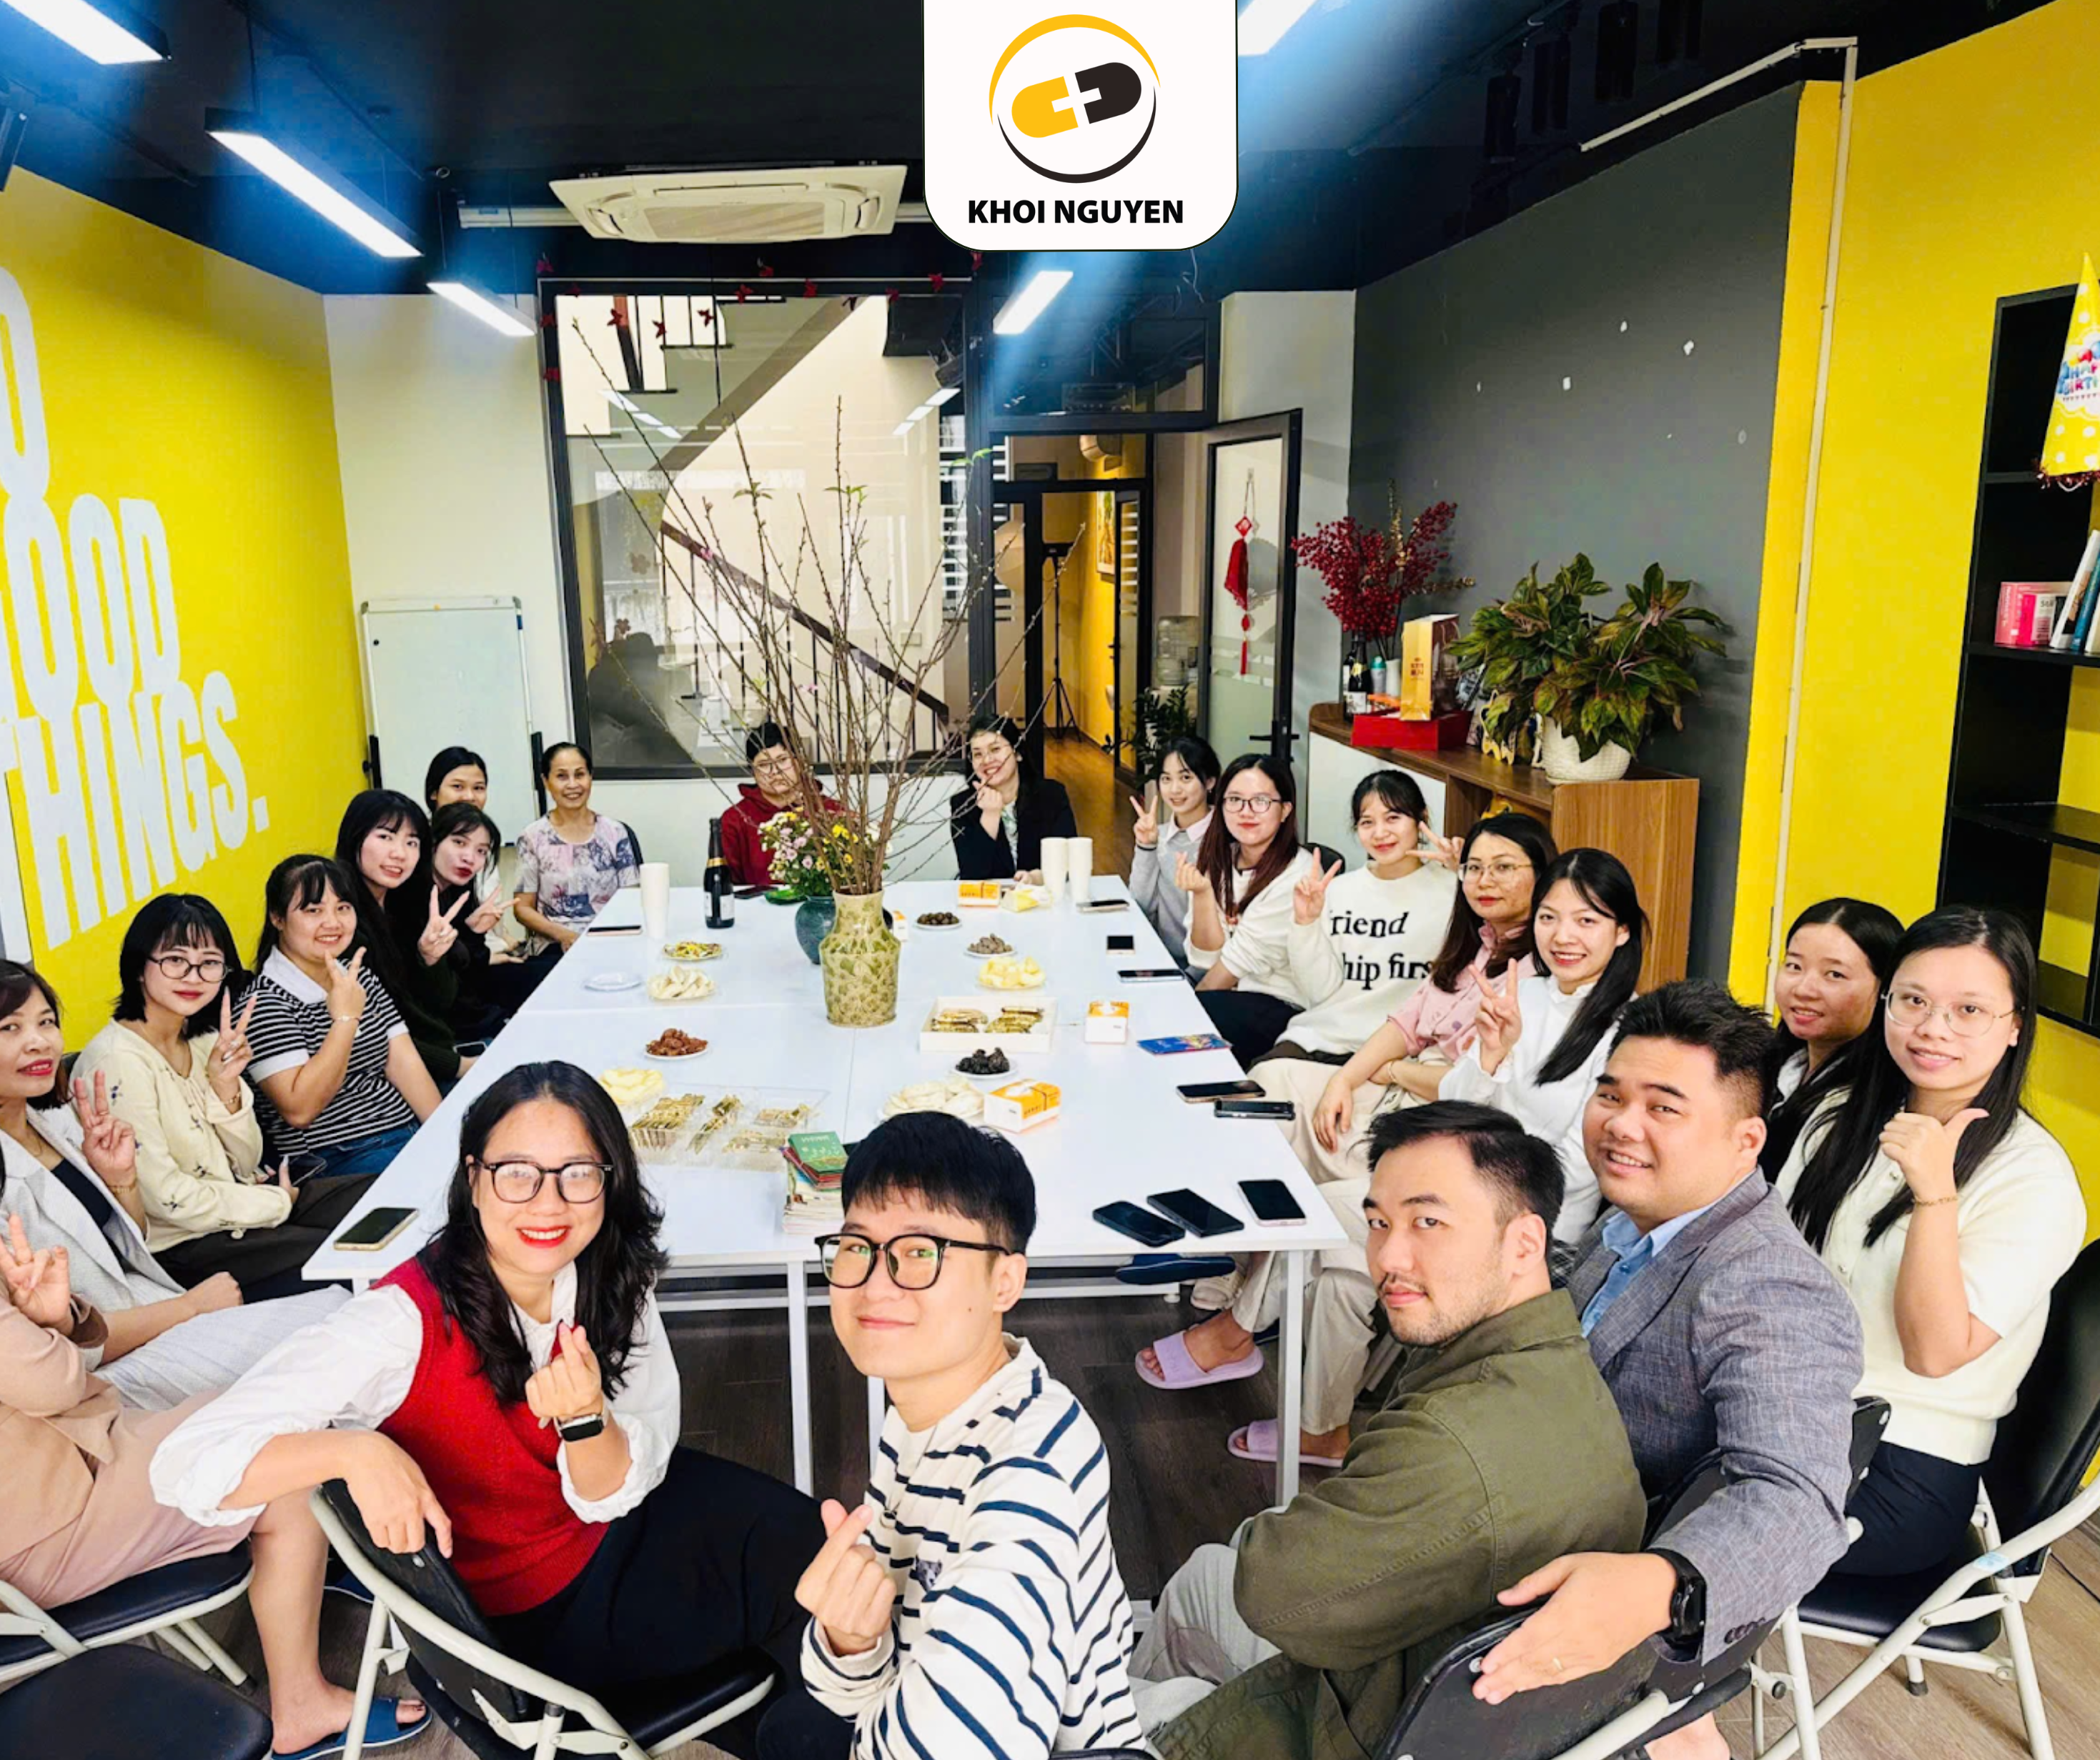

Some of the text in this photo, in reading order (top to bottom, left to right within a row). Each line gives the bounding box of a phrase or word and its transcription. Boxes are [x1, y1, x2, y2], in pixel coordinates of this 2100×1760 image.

[0, 492, 181, 719] OOD
[1329, 910, 1410, 938] riend
[1342, 953, 1432, 990] hip firs
